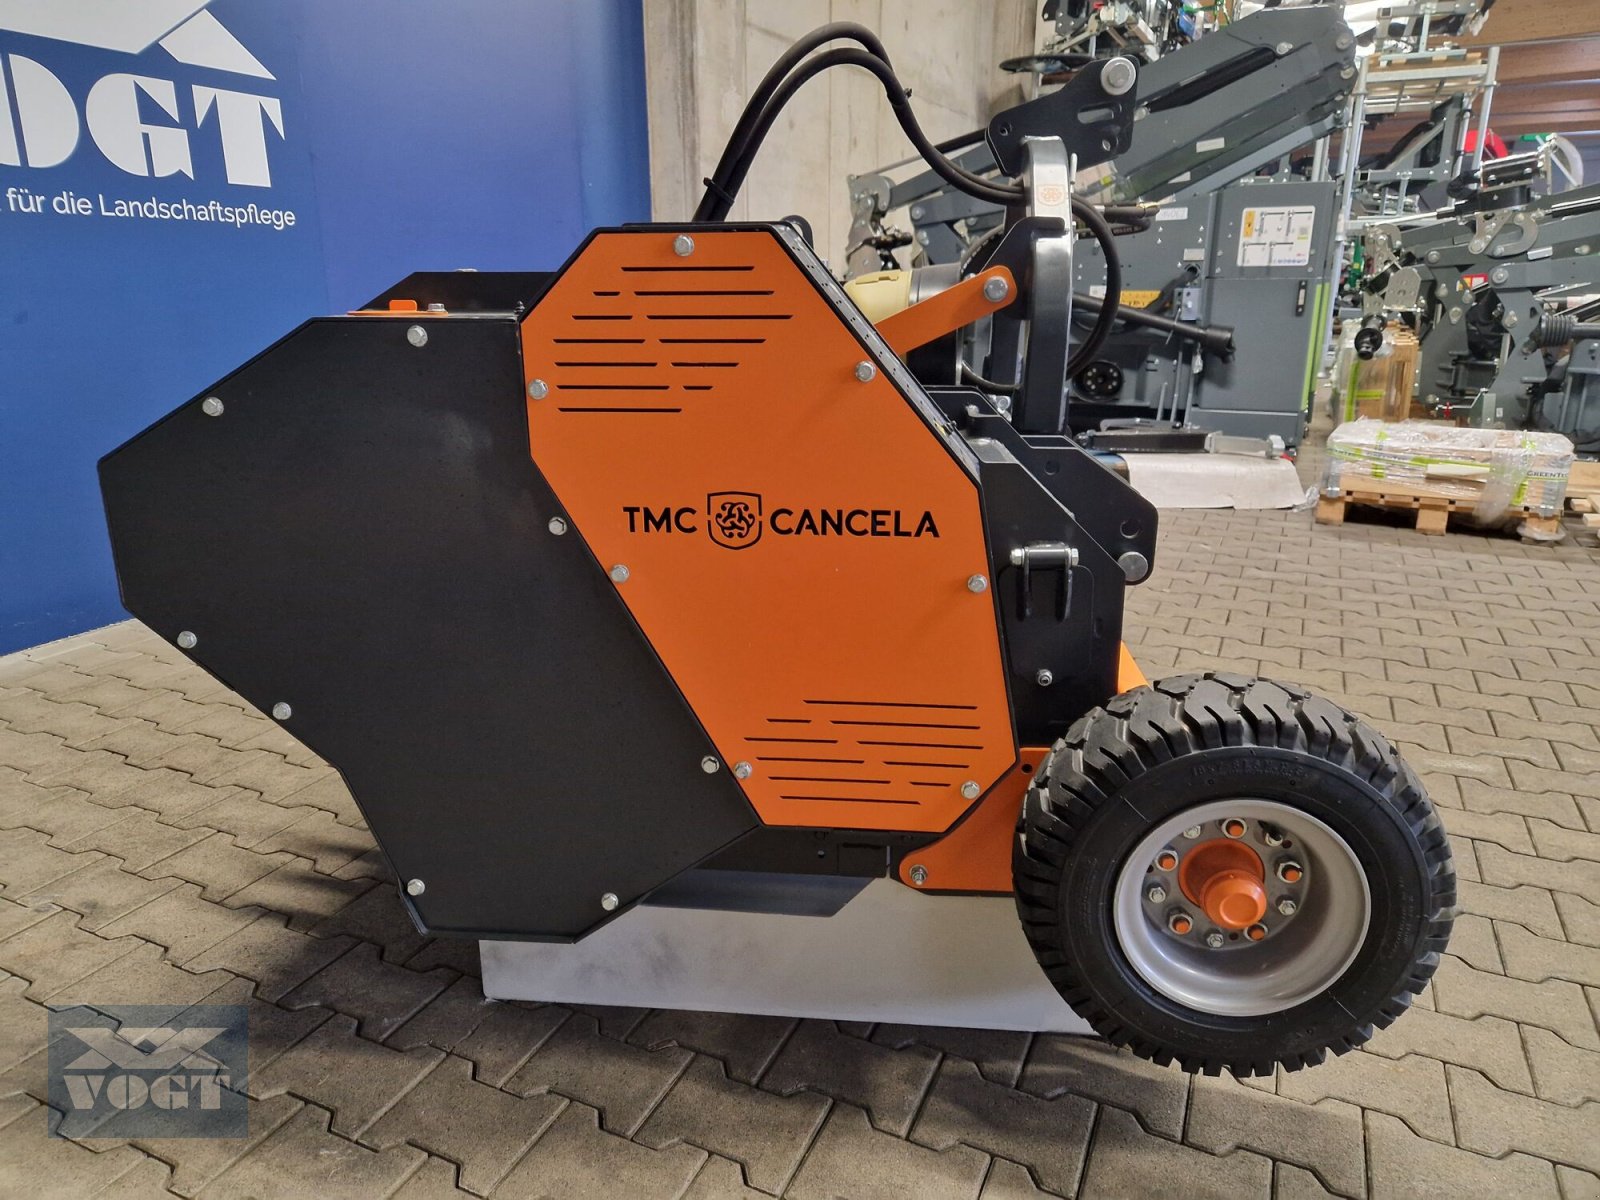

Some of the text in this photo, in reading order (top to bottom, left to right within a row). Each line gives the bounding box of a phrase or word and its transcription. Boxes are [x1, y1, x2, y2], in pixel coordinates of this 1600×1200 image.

[6, 188, 296, 230] für die Landschaftspflege
[623, 506, 940, 538] TMC CANCELA
